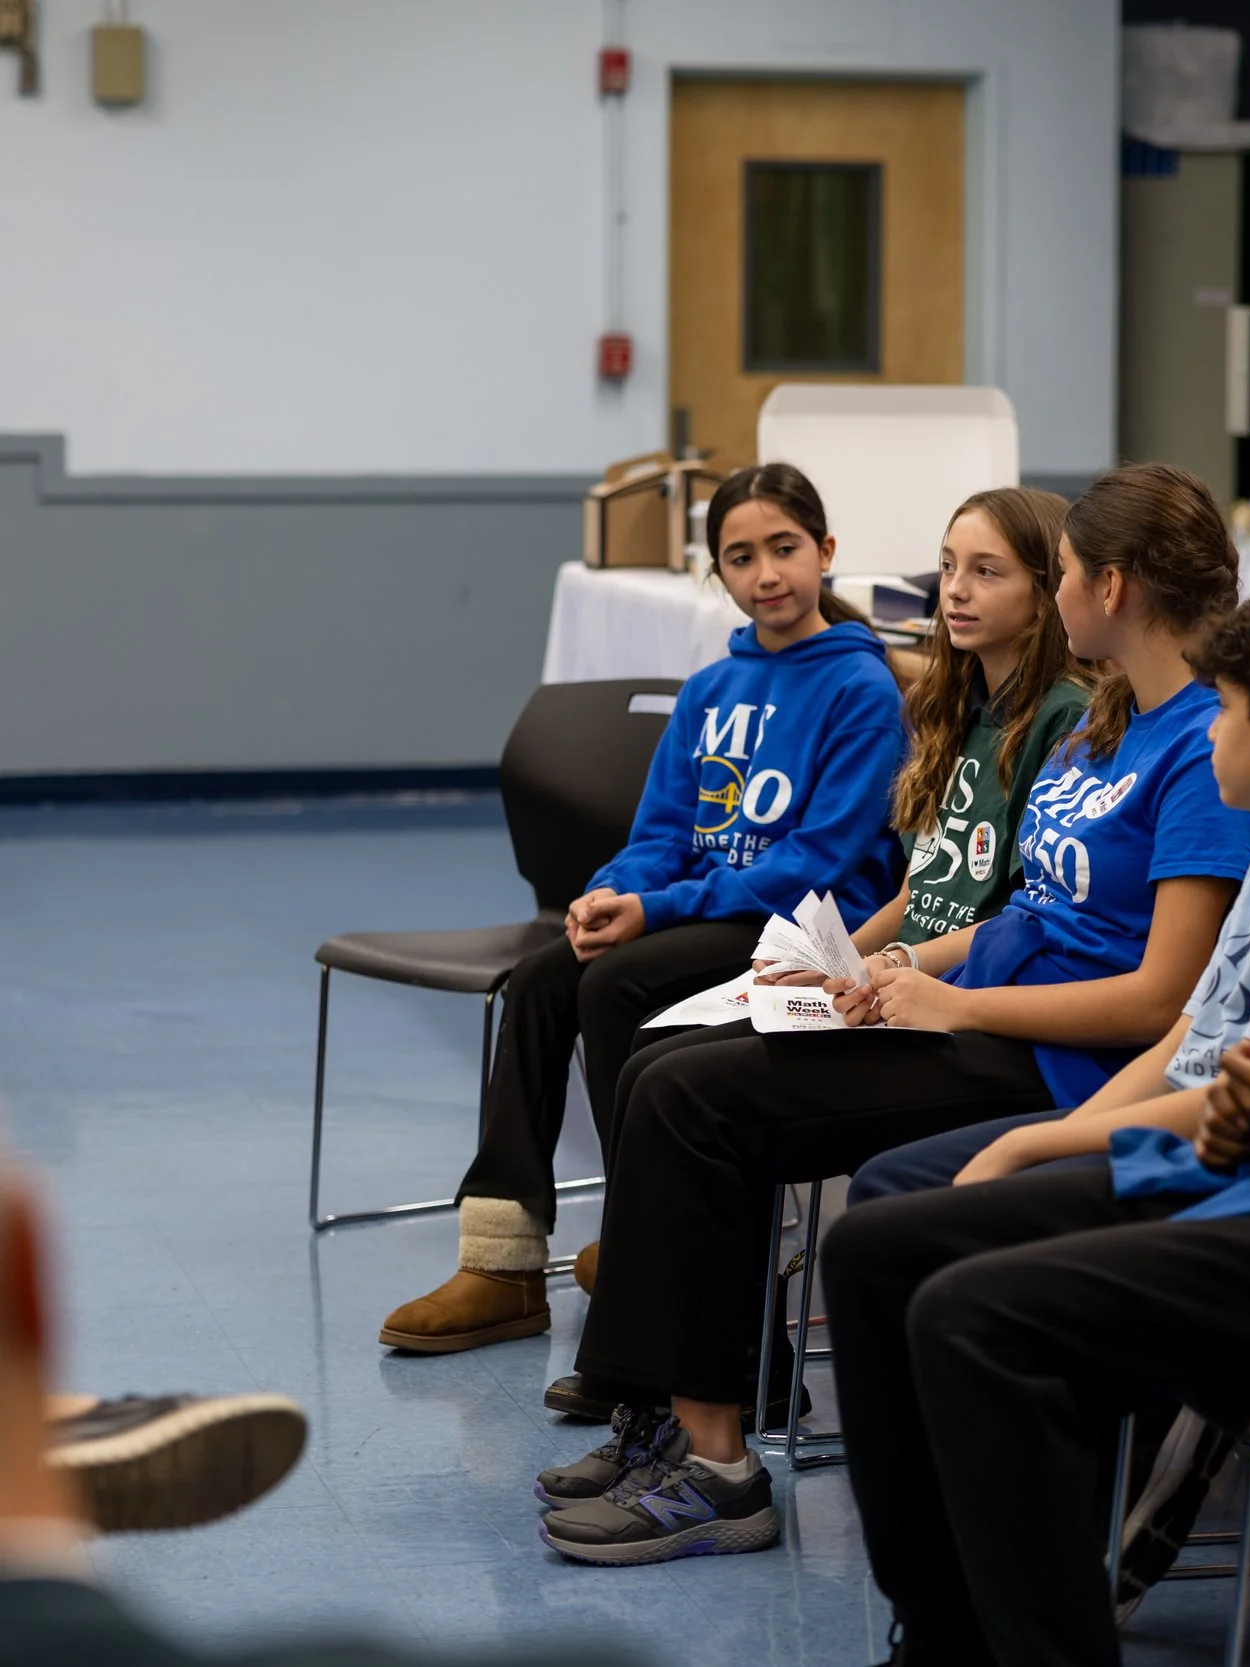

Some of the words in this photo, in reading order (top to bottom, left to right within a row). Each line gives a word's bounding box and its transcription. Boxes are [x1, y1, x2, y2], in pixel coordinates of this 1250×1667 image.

[733, 832, 771, 850] THE
[921, 893, 944, 911] OF
[947, 901, 976, 923] THE
[787, 1000, 827, 1008] Math
[787, 1006, 830, 1014] Week
